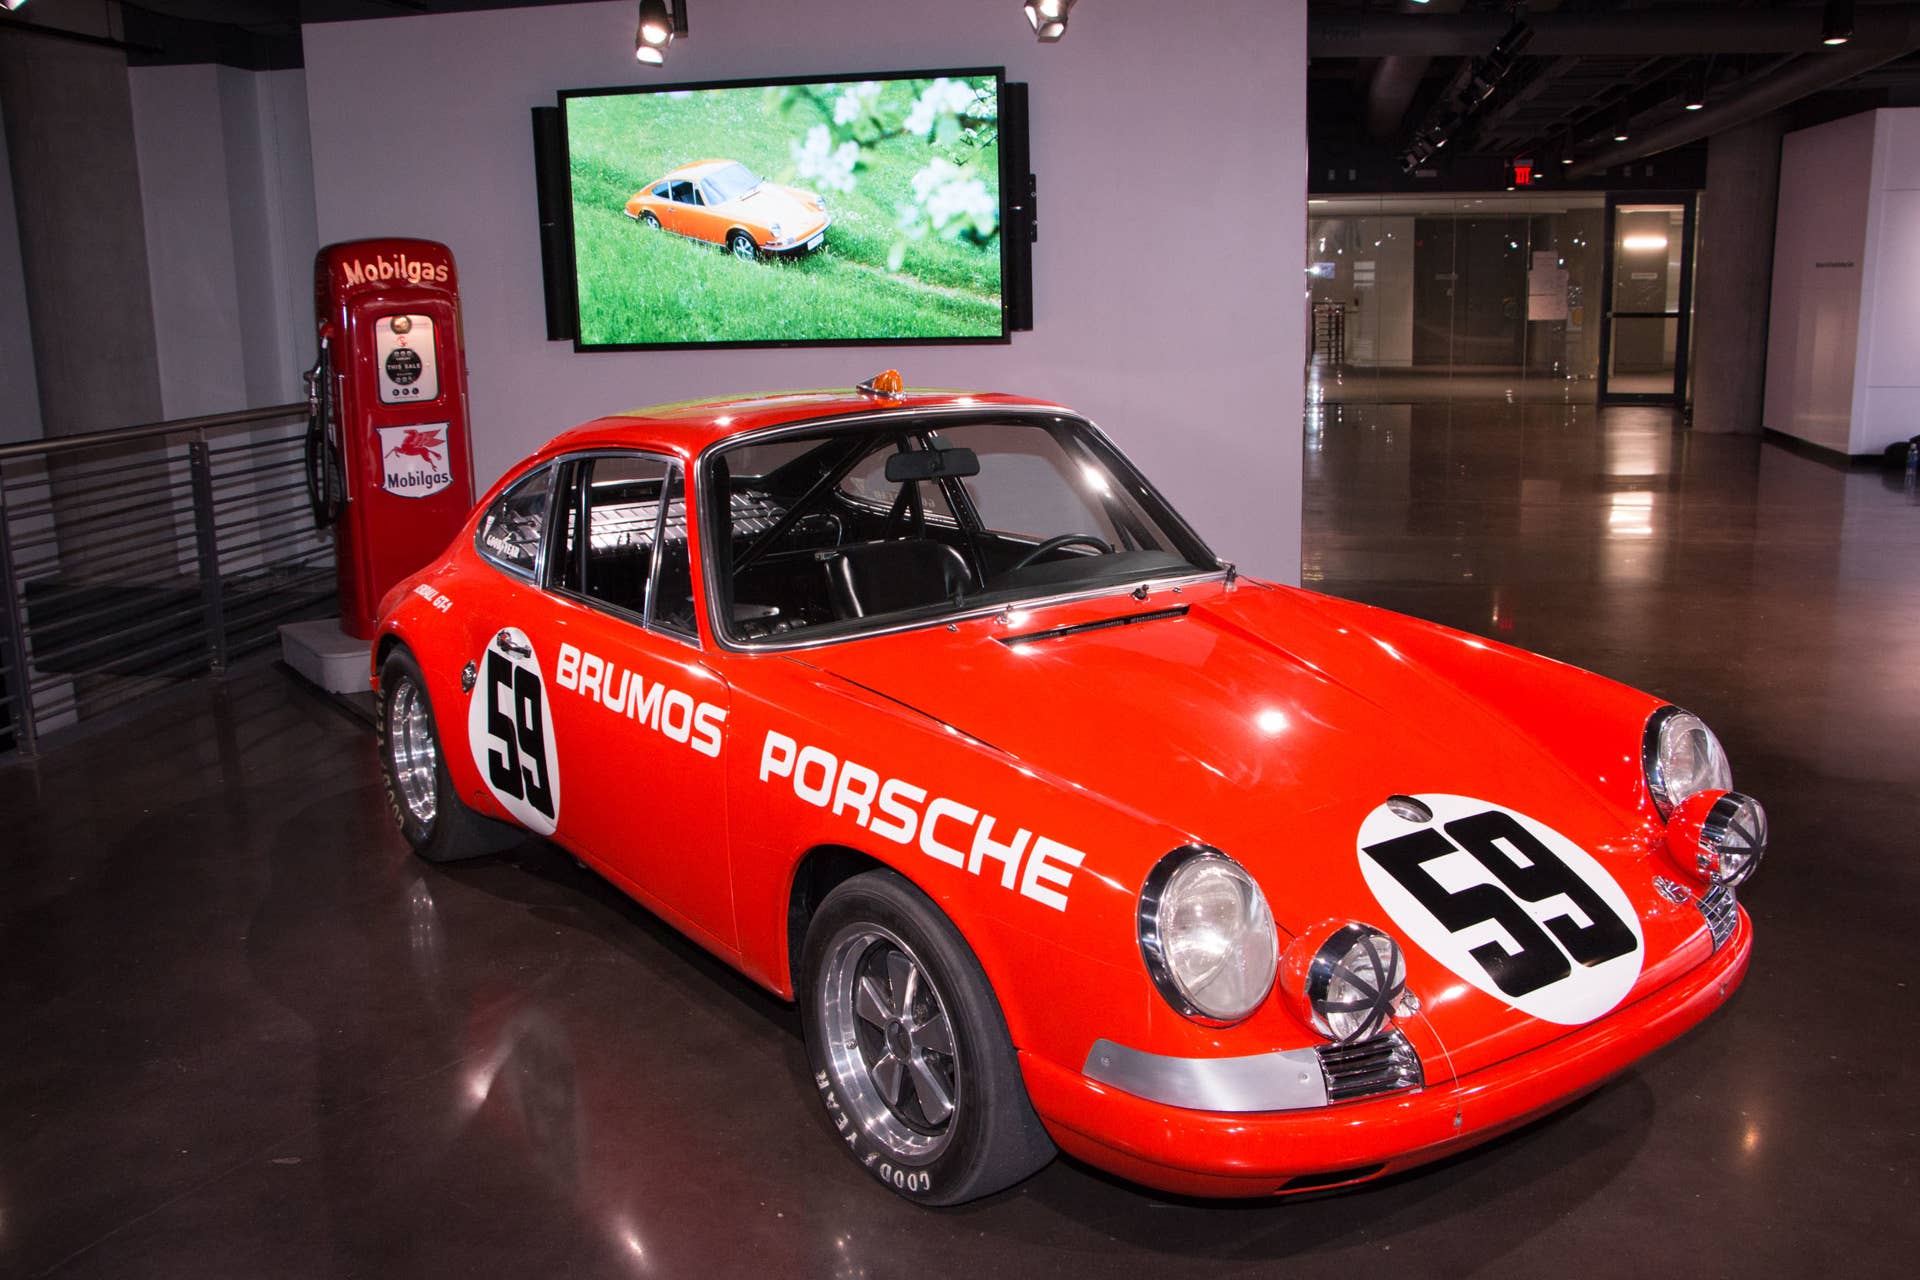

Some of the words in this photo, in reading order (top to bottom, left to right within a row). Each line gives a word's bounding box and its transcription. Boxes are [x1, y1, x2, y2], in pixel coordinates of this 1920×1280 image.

[342, 253, 449, 284] Mobilgas
[387, 469, 449, 489] Mobilgas
[487, 649, 556, 820] 59
[555, 643, 728, 758] BRUMOS
[759, 729, 1086, 913] PORSCHE
[1361, 810, 1638, 997] 59
